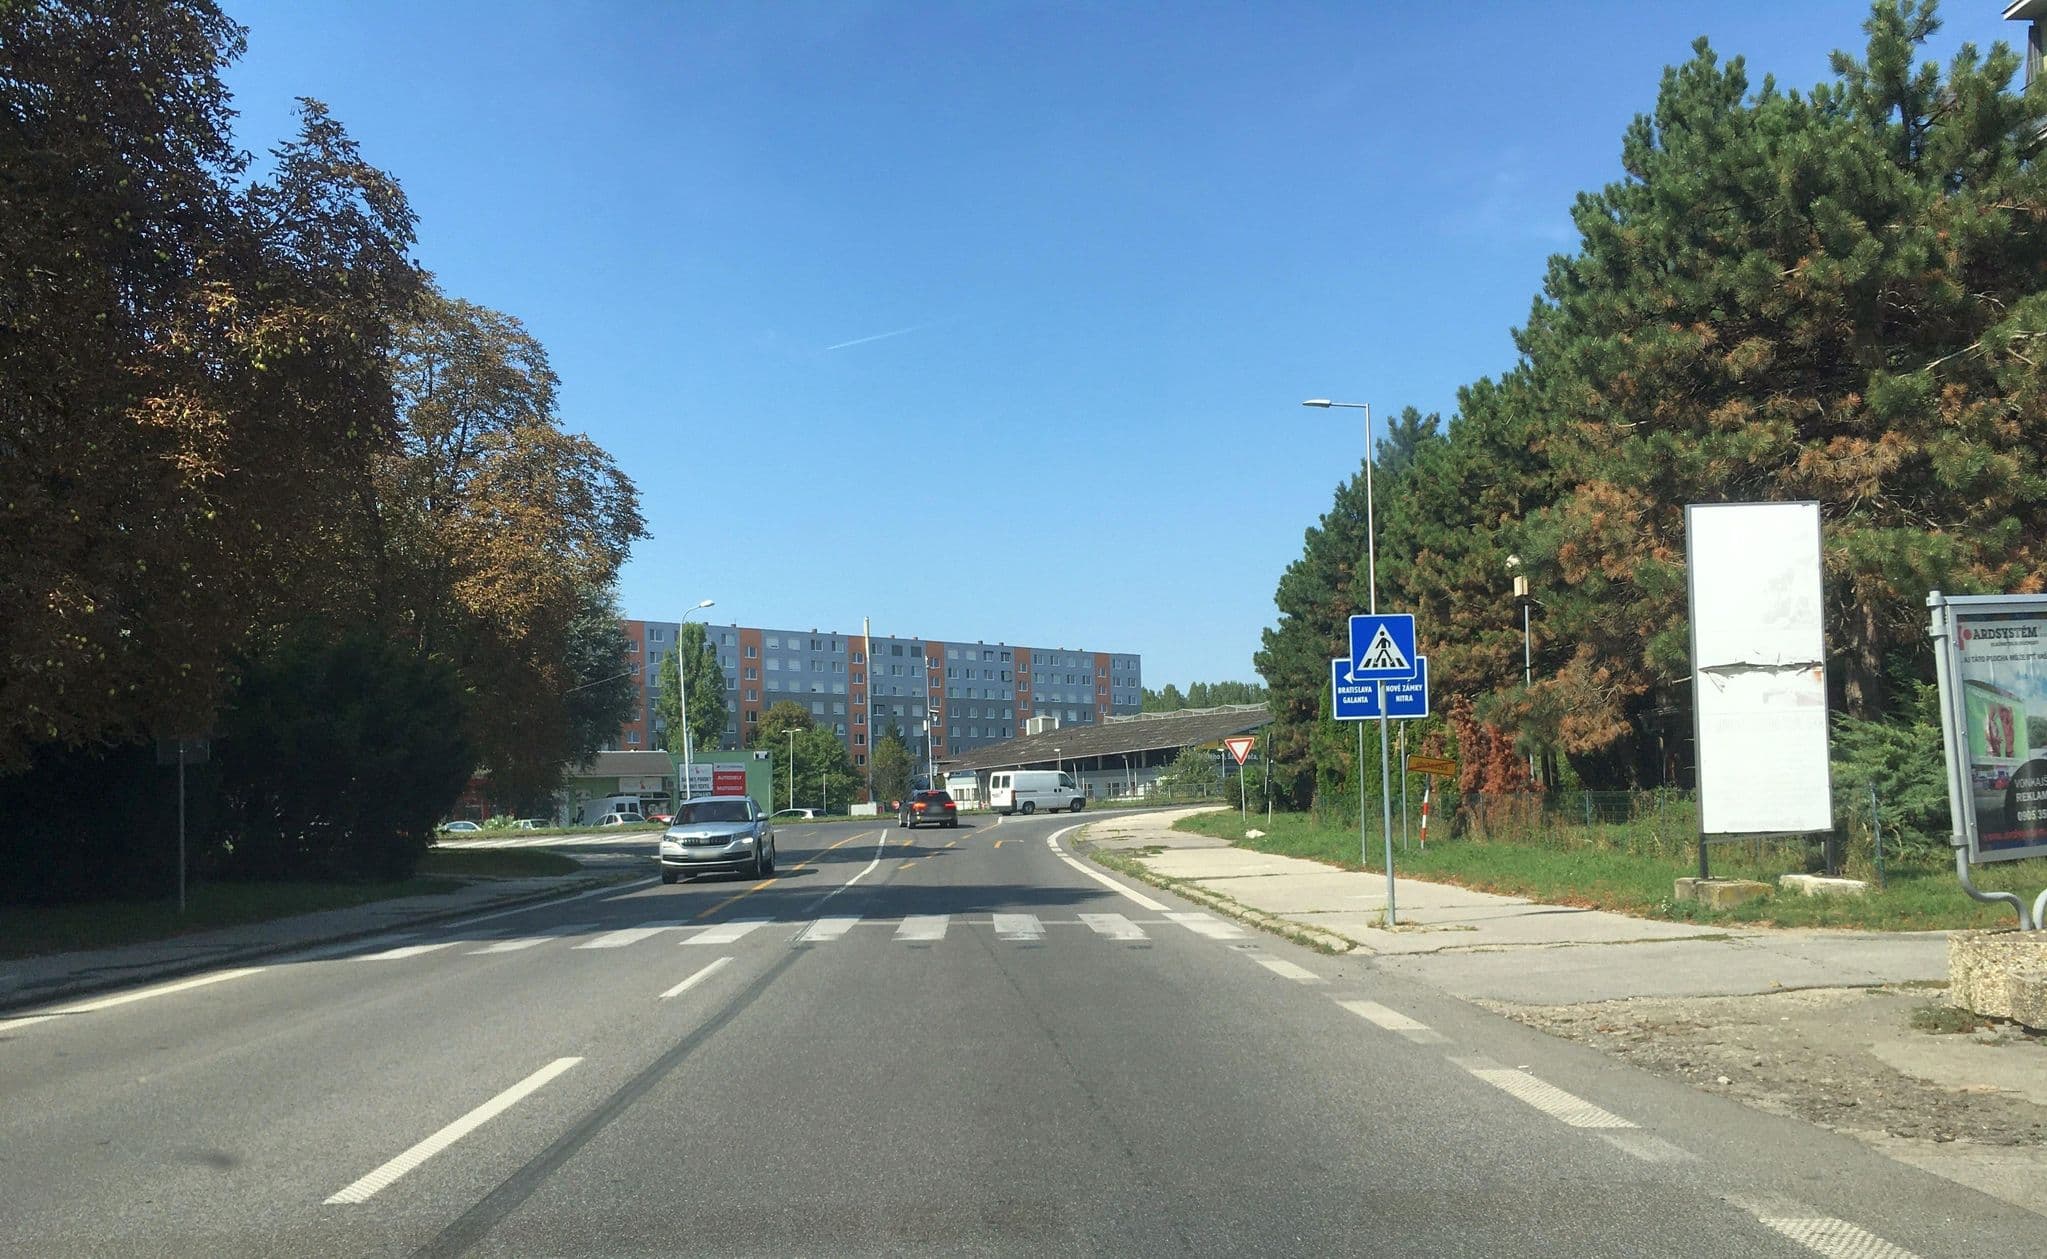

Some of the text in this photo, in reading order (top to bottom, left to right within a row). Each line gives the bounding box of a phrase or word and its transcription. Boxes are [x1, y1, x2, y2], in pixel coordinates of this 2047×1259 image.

[1338, 686, 1373, 694] BRATISLAVA
[1386, 683, 1423, 692] NOVÉ ZÁMKY
[1343, 696, 1369, 704] GALANTA
